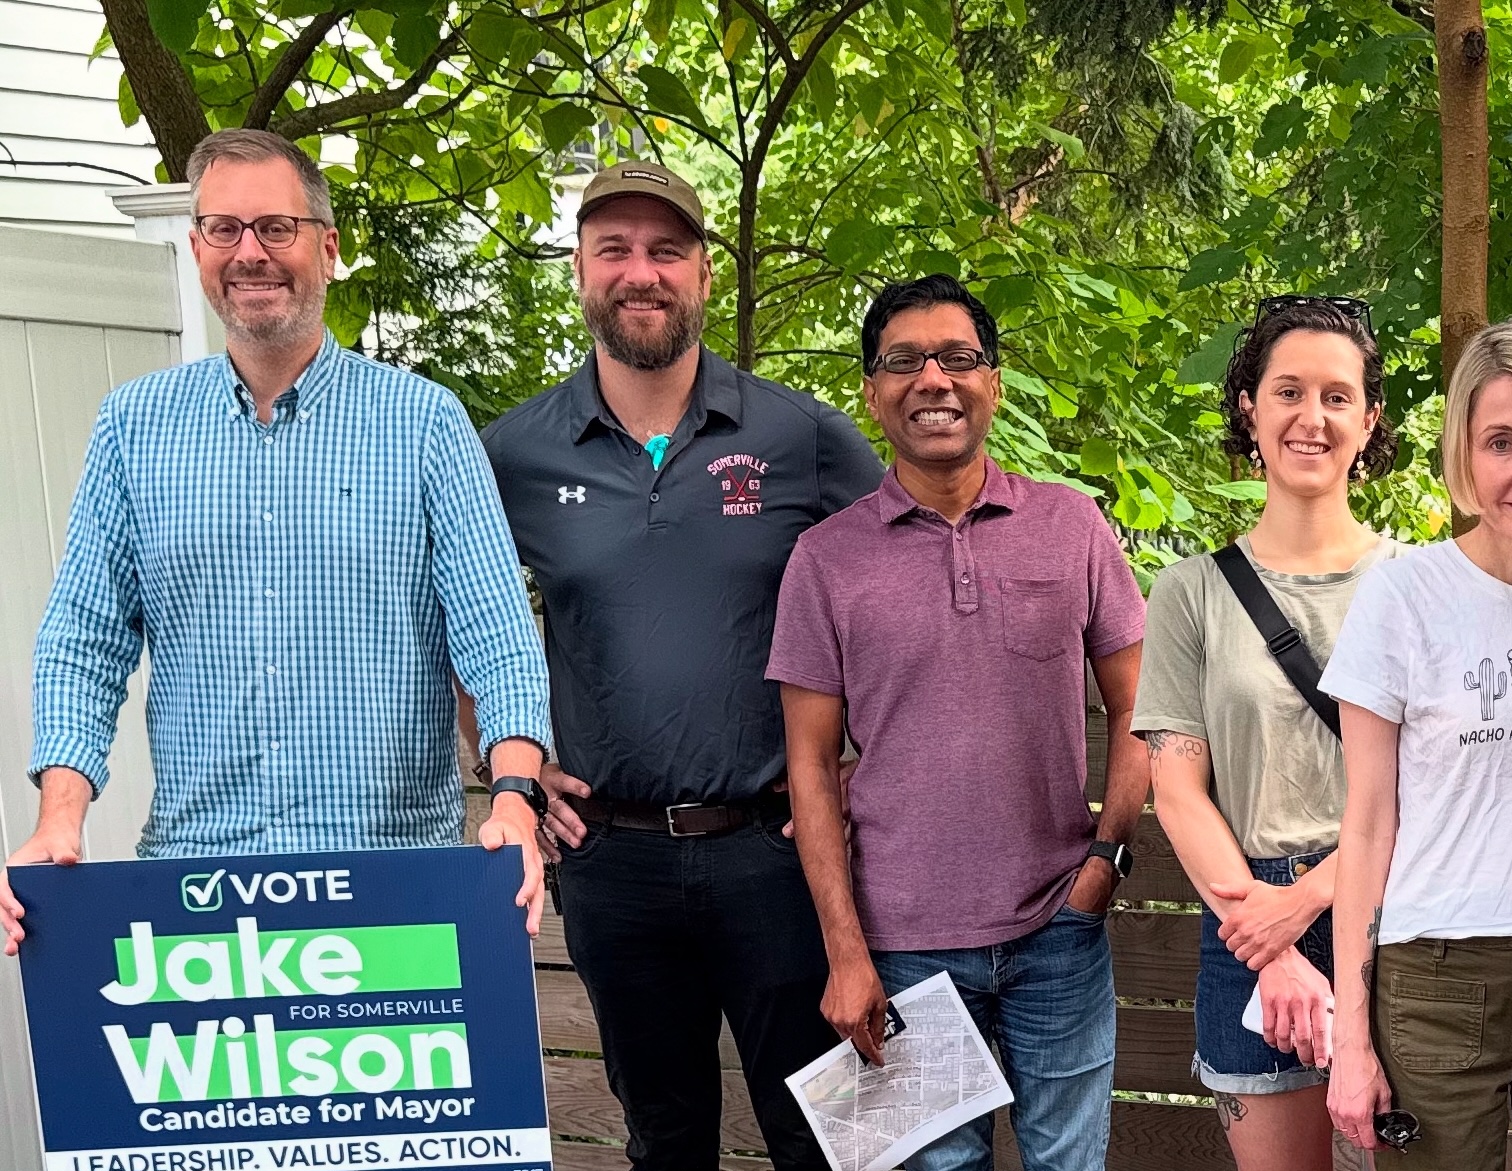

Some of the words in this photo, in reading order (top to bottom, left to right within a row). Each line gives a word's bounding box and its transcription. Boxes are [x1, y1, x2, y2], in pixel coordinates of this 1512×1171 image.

[706, 454, 769, 476] SOMERVILLE
[721, 480, 731, 491] 19
[748, 479, 761, 491] 63
[722, 502, 762, 516] HOCKEY
[1459, 727, 1505, 747] NACHO
[229, 869, 353, 904] VOTE
[99, 916, 364, 1006] Jake
[289, 1003, 331, 1020] FOR
[337, 998, 465, 1018] SOMERVILLE
[101, 1013, 472, 1104] Wilson
[139, 1099, 311, 1133] Candidate
[318, 1097, 365, 1123] for
[375, 1093, 476, 1126] Mayor
[268, 1141, 390, 1169] VALUES.
[399, 1135, 521, 1162] ACTION.
